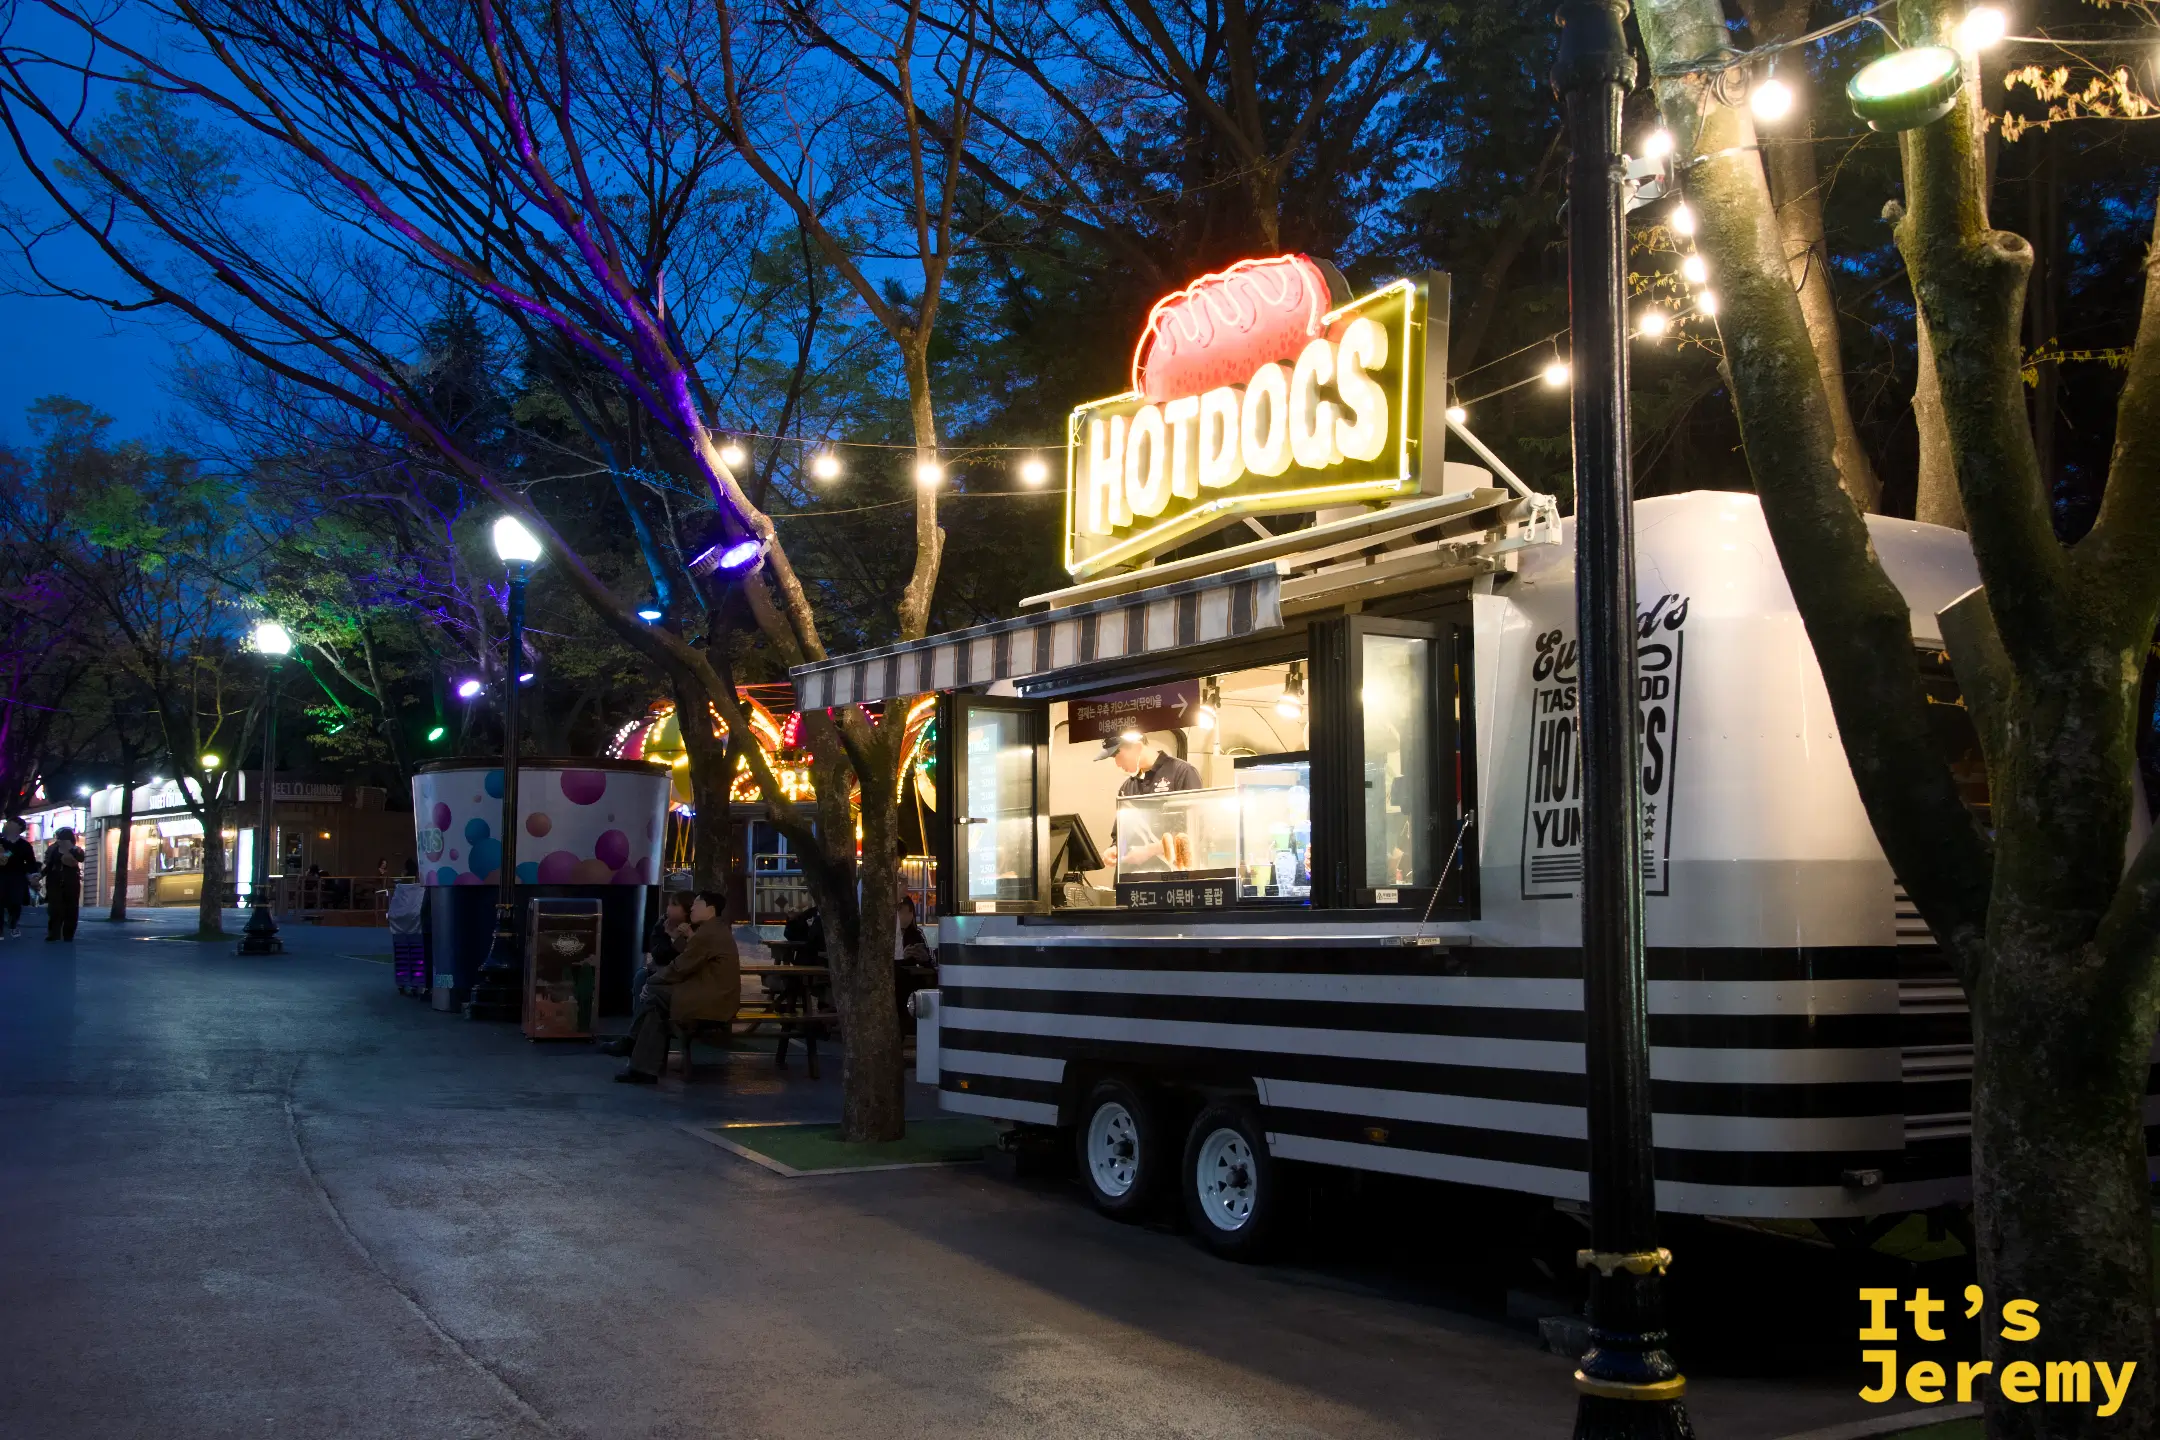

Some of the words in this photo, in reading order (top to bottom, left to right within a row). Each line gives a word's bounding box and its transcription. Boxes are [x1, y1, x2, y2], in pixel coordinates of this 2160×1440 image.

[1088, 317, 1389, 535] HOTDOGS
[1077, 704, 1096, 721] 결제는
[1096, 704, 1109, 717] 우측
[1110, 694, 1162, 714] 키오스크(무인)을
[305, 783, 342, 796] CHURROS
[1130, 890, 1157, 907] 핫도그
[1166, 888, 1194, 907] 어묵바
[1203, 887, 1224, 906] 콜팝
